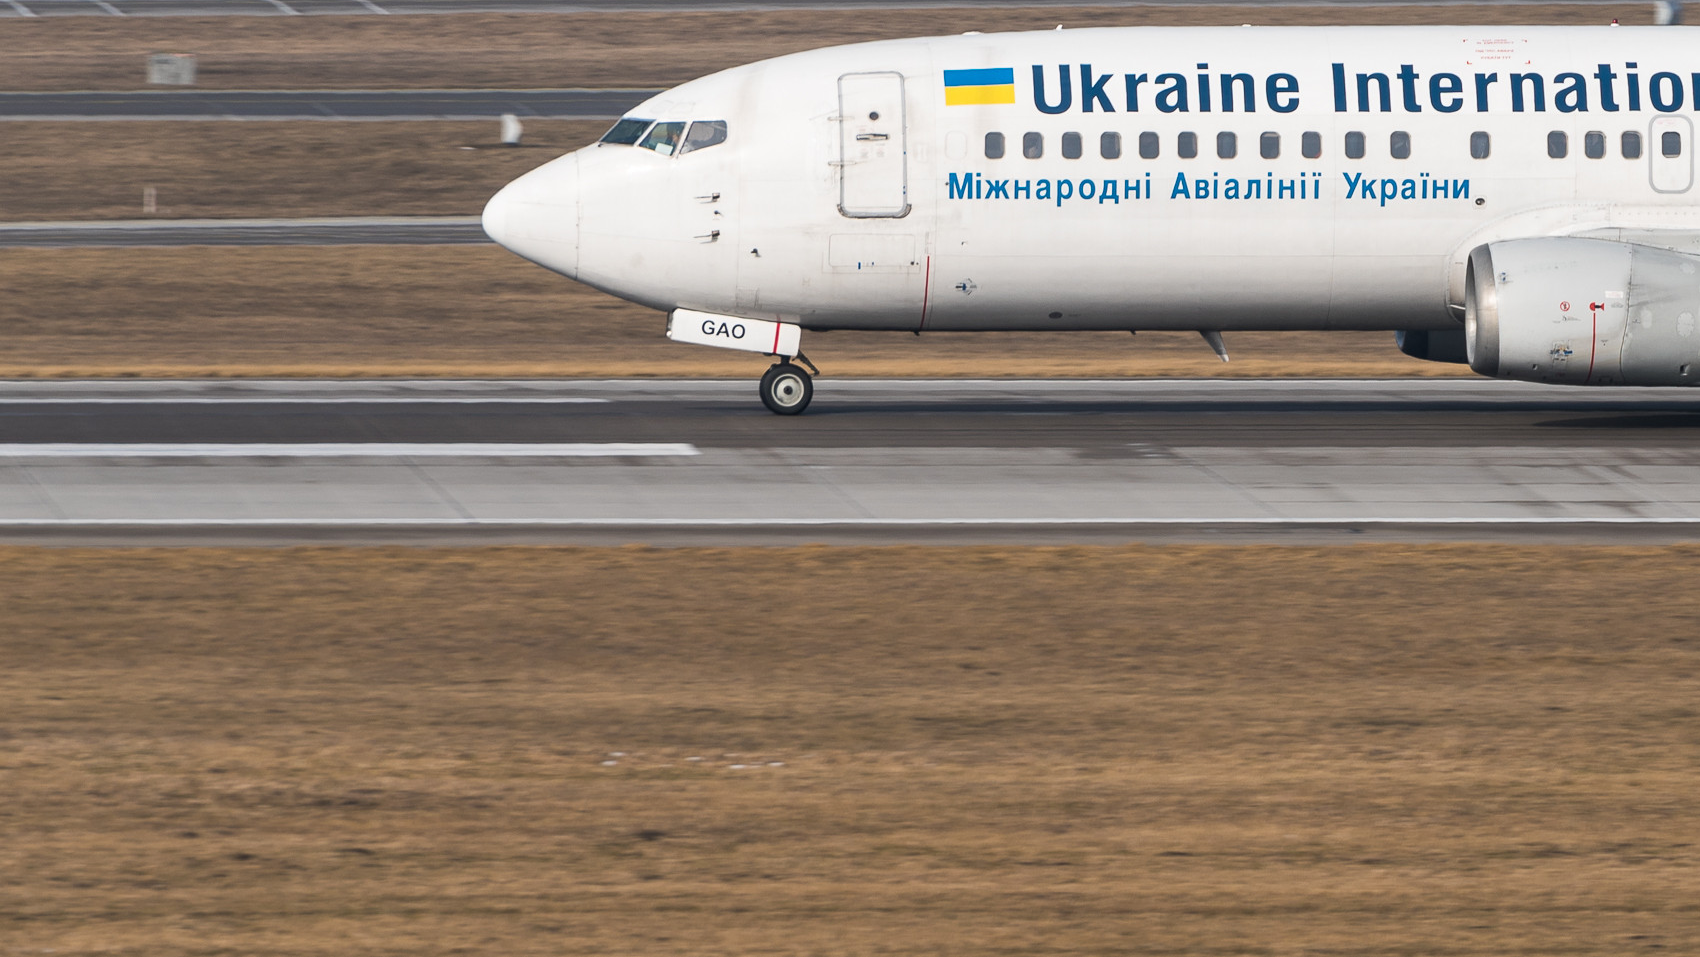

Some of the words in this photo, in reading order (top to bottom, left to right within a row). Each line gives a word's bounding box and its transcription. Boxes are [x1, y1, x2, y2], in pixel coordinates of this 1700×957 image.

[1031, 62, 1300, 115] Ukraine
[948, 171, 1151, 208] Міжнародні
[1170, 171, 1322, 200] Авіалінії
[1342, 171, 1471, 208] України
[701, 319, 746, 339] GAO
